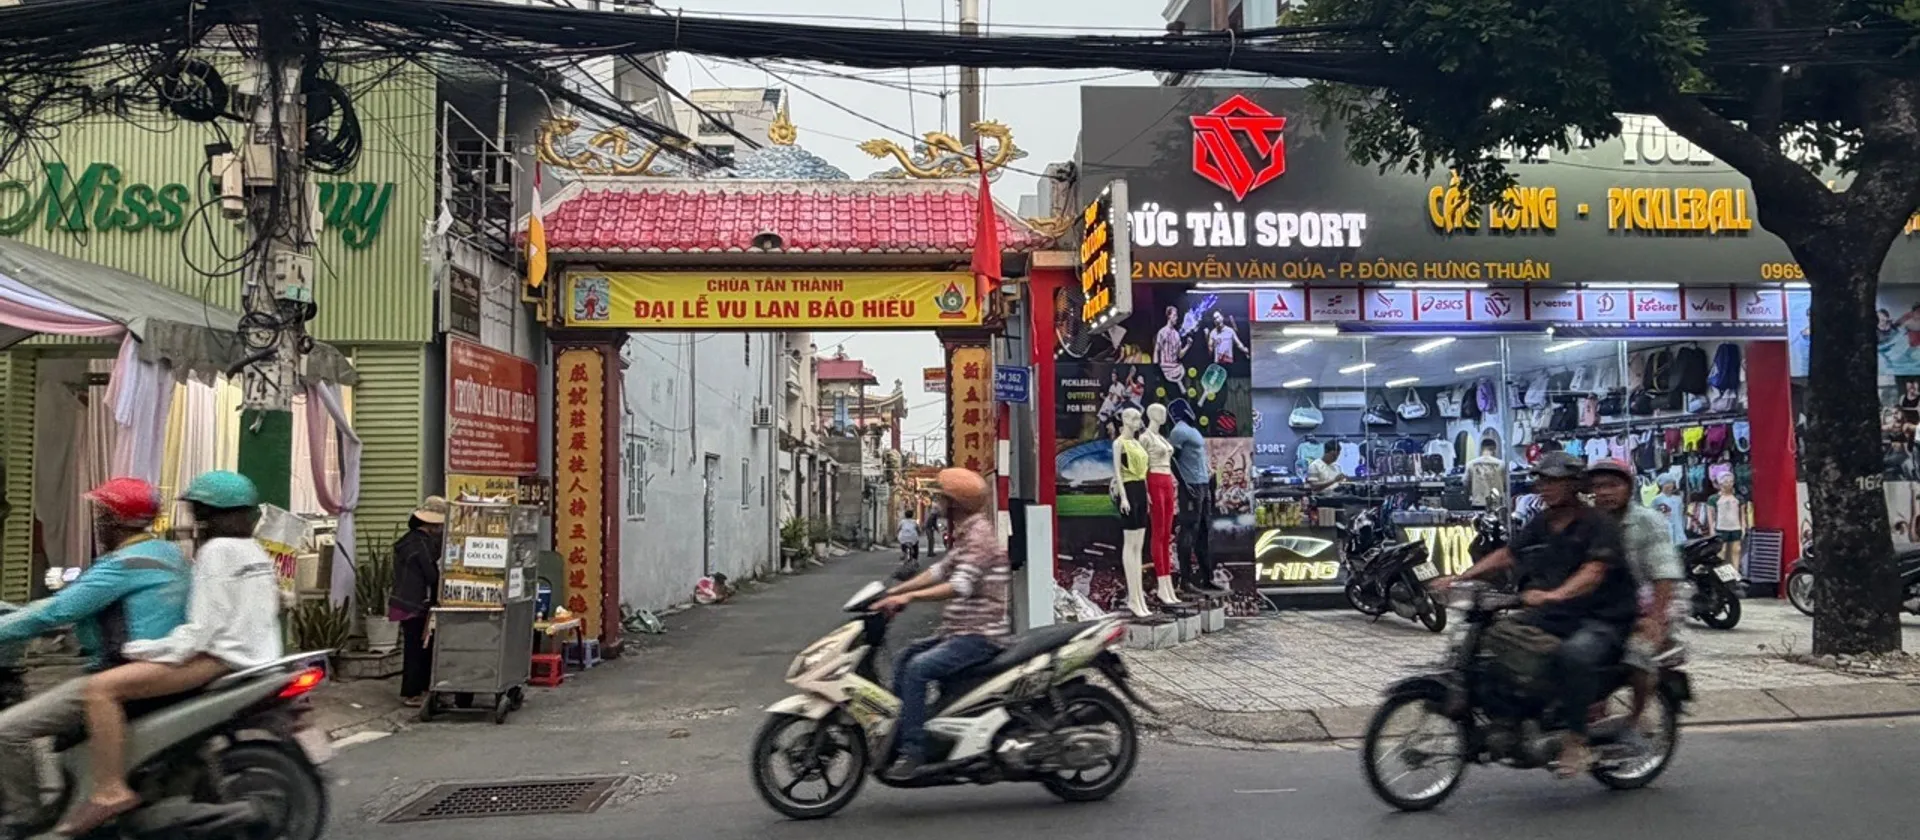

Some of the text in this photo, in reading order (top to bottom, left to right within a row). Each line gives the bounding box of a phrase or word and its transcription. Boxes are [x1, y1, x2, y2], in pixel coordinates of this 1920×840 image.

[0, 162, 190, 235] Miss
[1607, 187, 1752, 234] PICKLEBALL
[1186, 202, 1246, 247] TÀI
[1256, 211, 1368, 248] SPORT
[1149, 254, 1231, 279] NGUYỄN
[1236, 258, 1276, 279] VĂN
[1358, 257, 1417, 279] ĐÔNG
[1423, 260, 1481, 279] HƯNG
[1484, 260, 1550, 281] THUẬN
[707, 277, 844, 293] CHÙA TÂN THÀNH
[634, 293, 915, 322] ĐẠI LỄ VU LAN BÁO HIẾU
[1061, 379, 1101, 387] PICKLEBALL
[1067, 392, 1096, 400] OUTFITS
[1067, 404, 1097, 412] FOR MEN
[1256, 444, 1286, 454] SPORT
[1855, 473, 1884, 490] 162
[1256, 561, 1340, 581] I-NING
